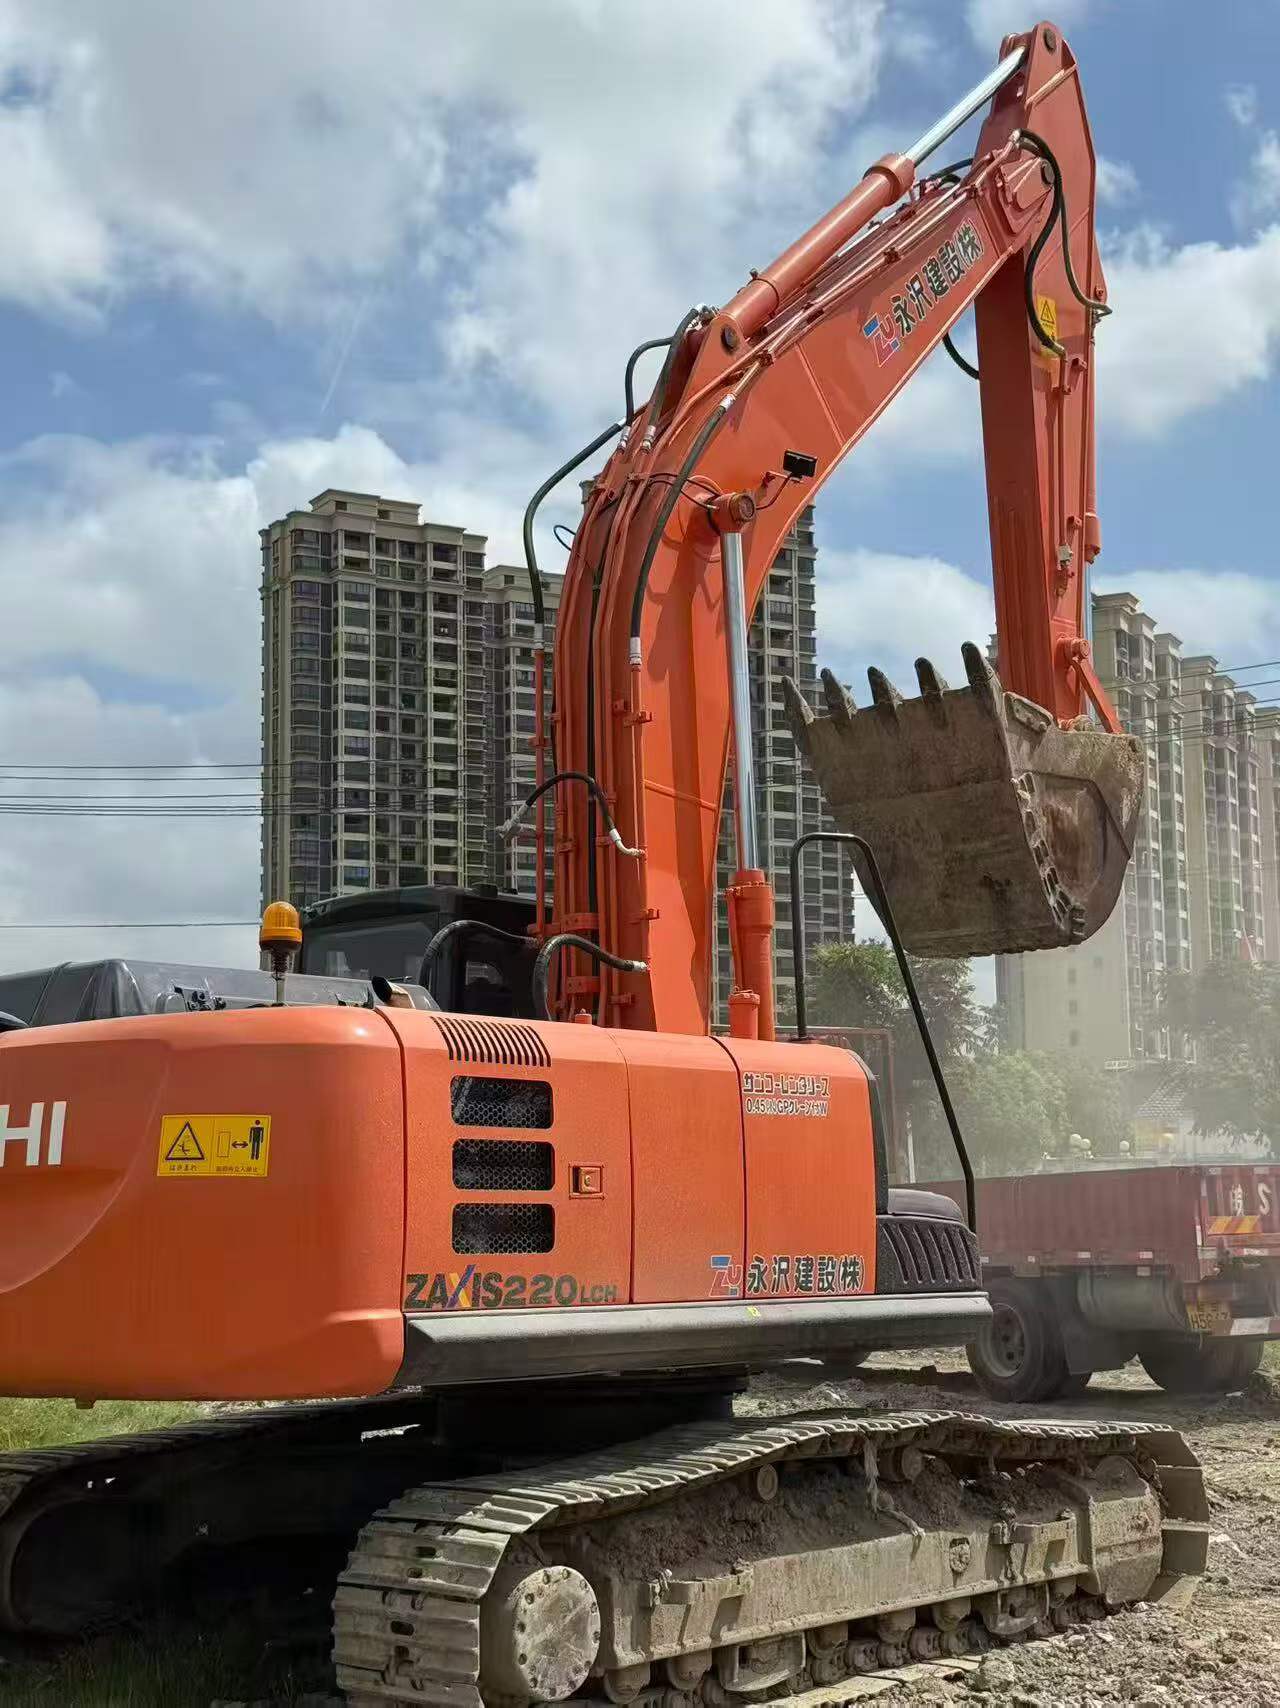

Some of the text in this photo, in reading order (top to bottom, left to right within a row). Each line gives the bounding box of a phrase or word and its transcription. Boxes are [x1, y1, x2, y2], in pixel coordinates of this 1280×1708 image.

[891, 216, 985, 337] 永沢建設(株)
[746, 1254, 866, 1294] 永沢建設(株)
